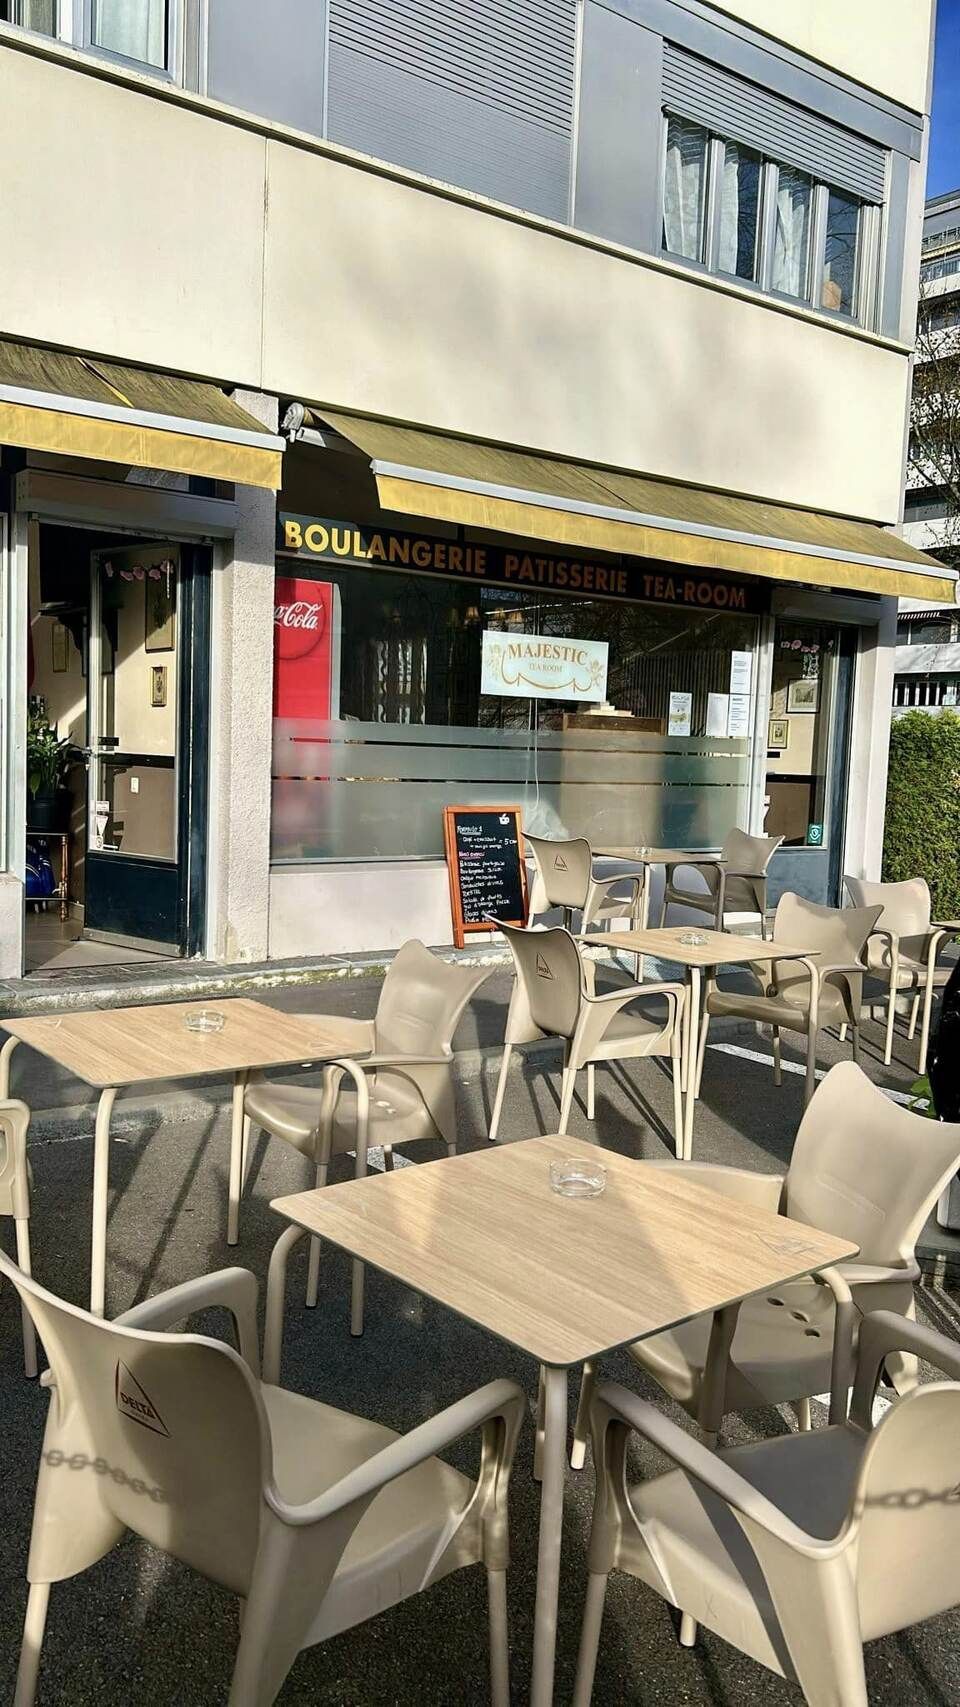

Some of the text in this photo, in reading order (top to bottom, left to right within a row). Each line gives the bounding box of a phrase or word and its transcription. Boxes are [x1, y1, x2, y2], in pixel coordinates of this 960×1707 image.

[285, 520, 746, 608] BOULANGERIE PATISSERIE TEA-ROOM
[274, 601, 323, 629] a-Cola
[508, 643, 588, 665] MAJESTIC
[543, 664, 562, 672] ROOM
[120, 1391, 157, 1420] DELTA
